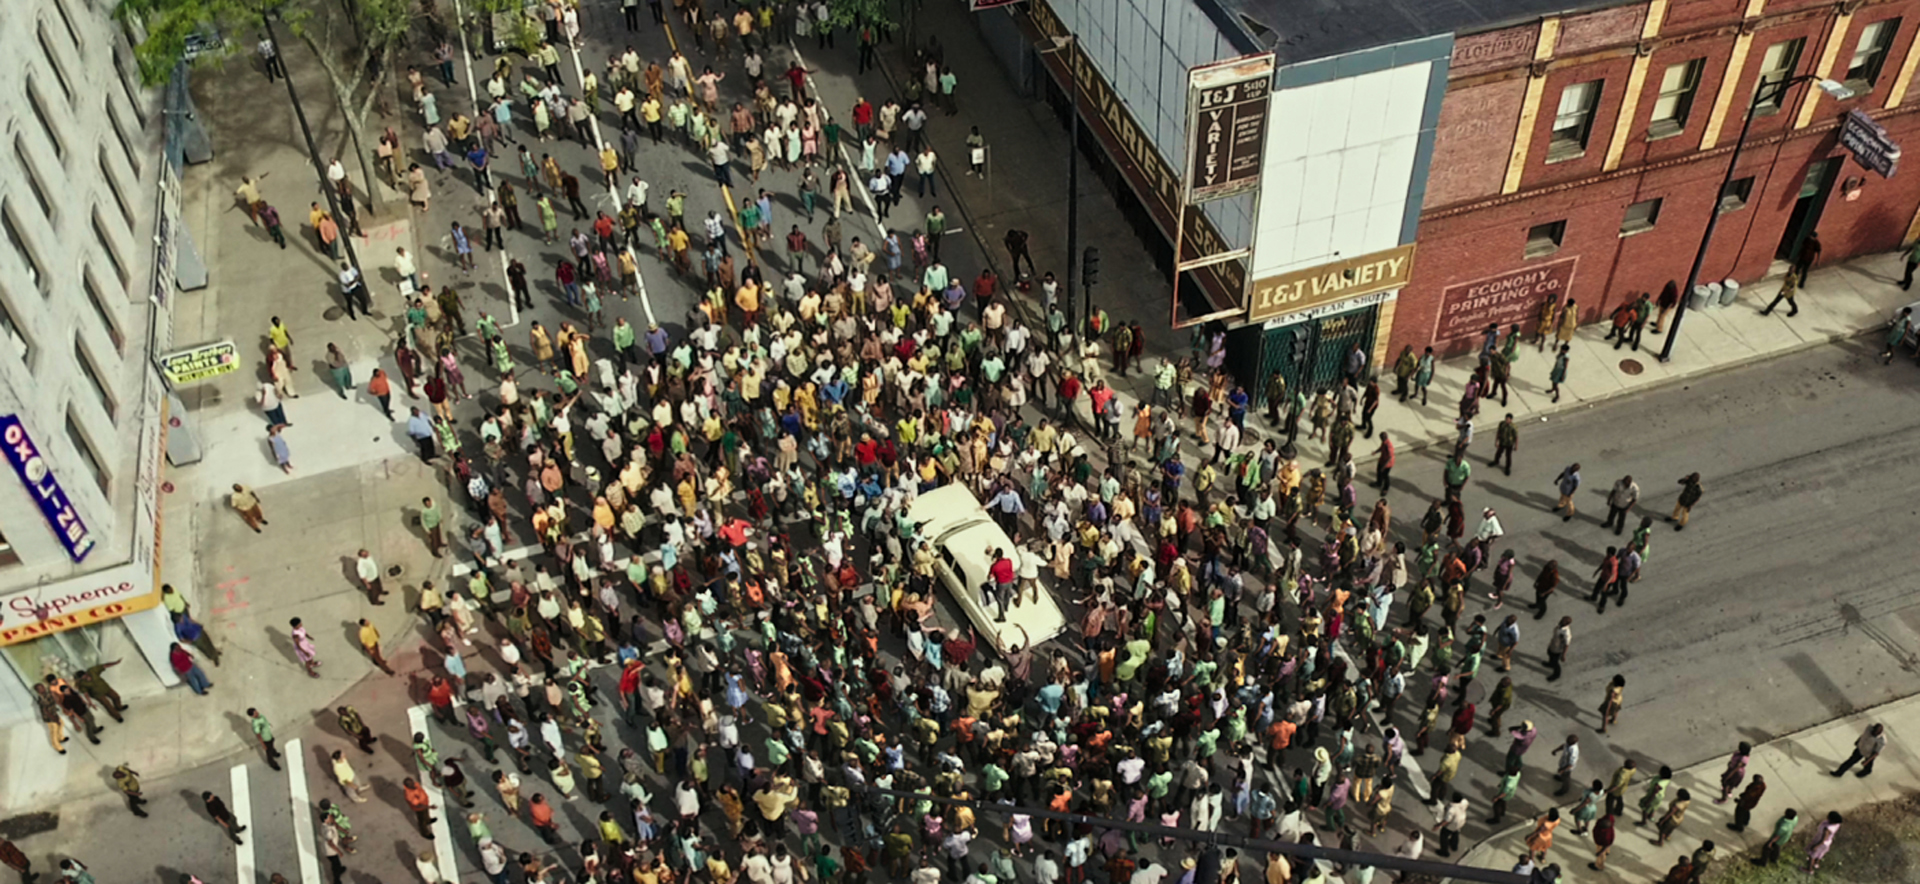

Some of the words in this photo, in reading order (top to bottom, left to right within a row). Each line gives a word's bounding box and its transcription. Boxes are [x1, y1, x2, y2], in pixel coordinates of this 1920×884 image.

[1201, 85, 1237, 108] I&J
[1204, 109, 1223, 186] VARIETY
[1258, 279, 1306, 309] I&J
[1310, 256, 1404, 296] VARIETY
[1449, 286, 1530, 314] PRINTING
[1535, 279, 1562, 293] CO.
[1467, 269, 1550, 299] ECONOMY
[1311, 301, 1345, 315] WEAR
[172, 357, 218, 374] PAINTS
[9, 581, 134, 618] Supreme
[3, 614, 77, 640] PAINT
